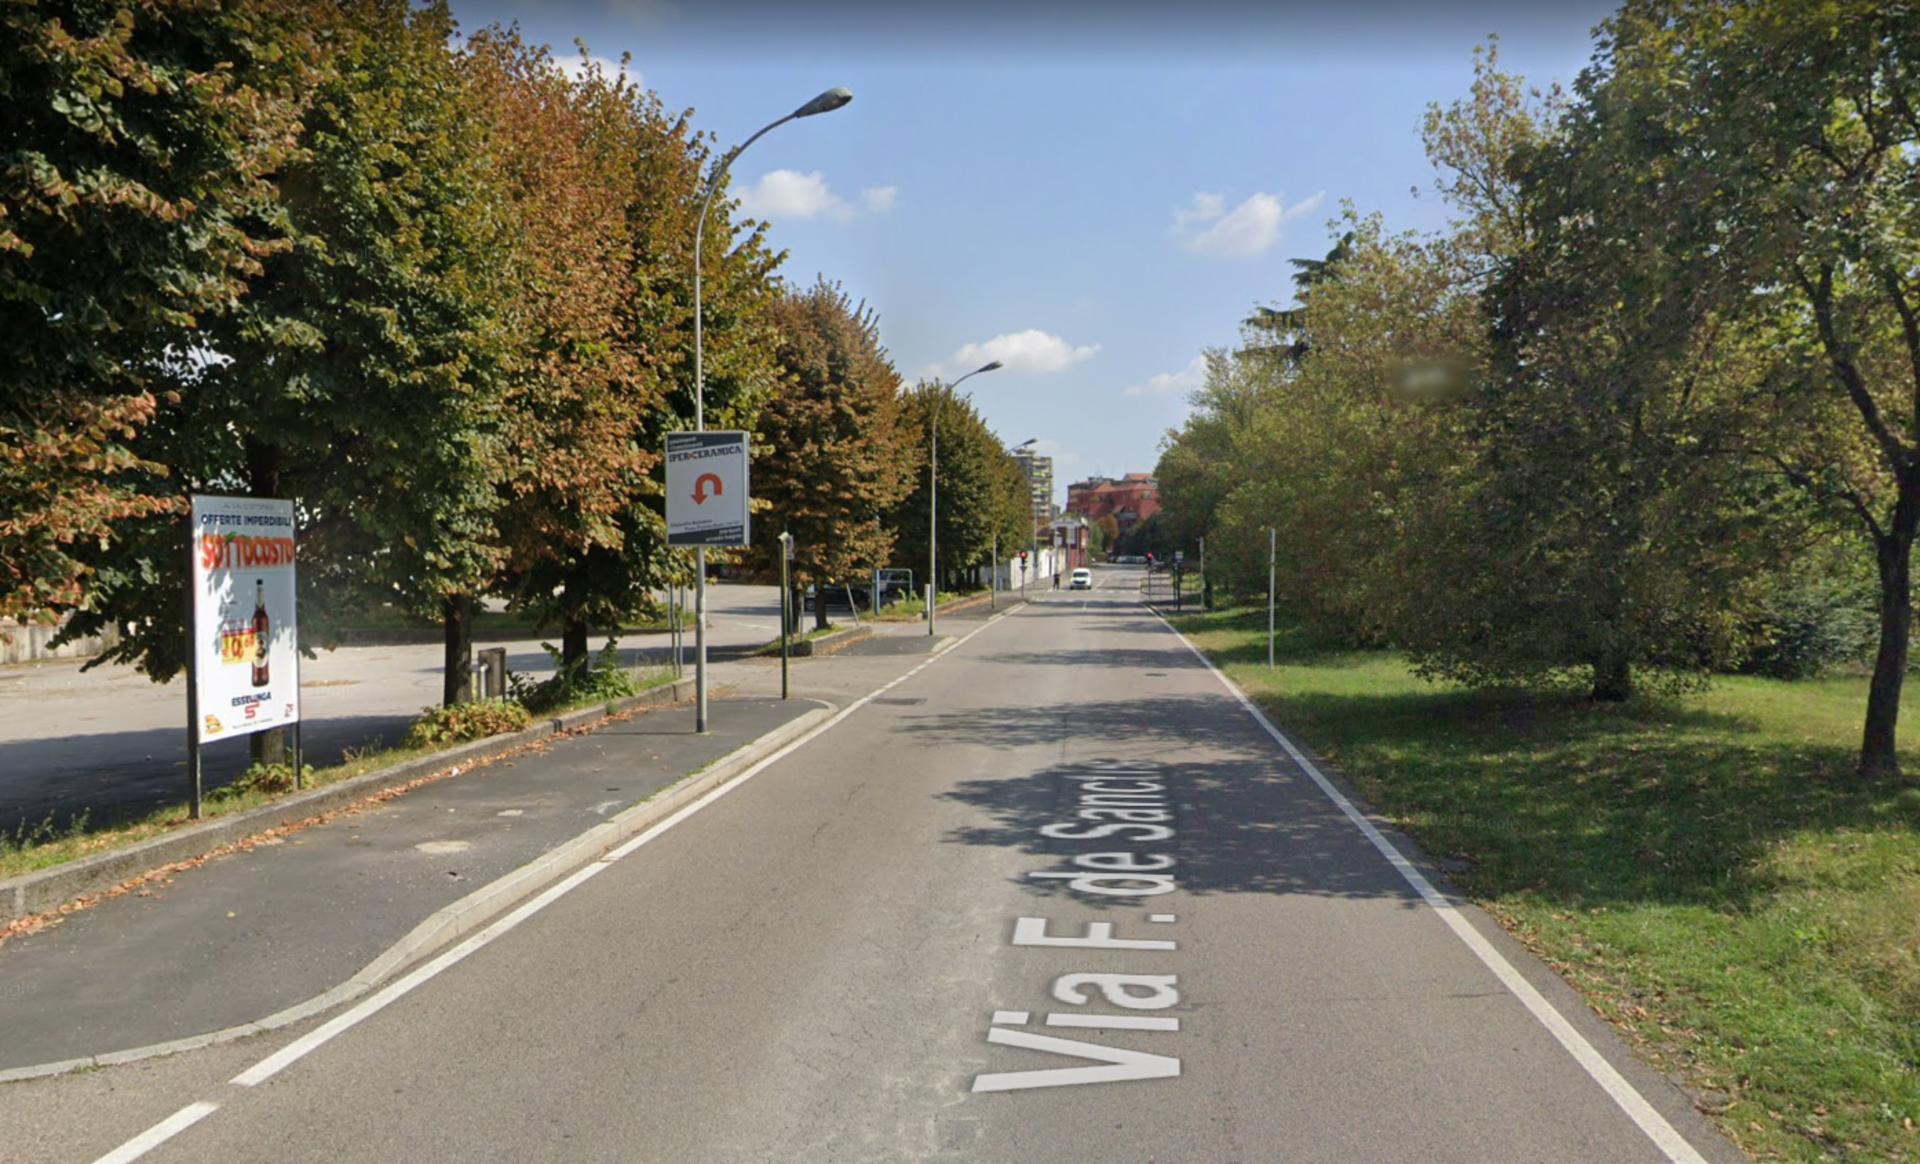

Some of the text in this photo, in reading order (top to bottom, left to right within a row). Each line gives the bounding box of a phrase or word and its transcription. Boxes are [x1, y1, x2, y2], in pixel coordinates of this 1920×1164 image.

[201, 514, 291, 527] OFFERTE IMPERDIBILI
[202, 533, 293, 570] SOTTOCOSTO
[231, 691, 272, 707] ESSELUNGA
